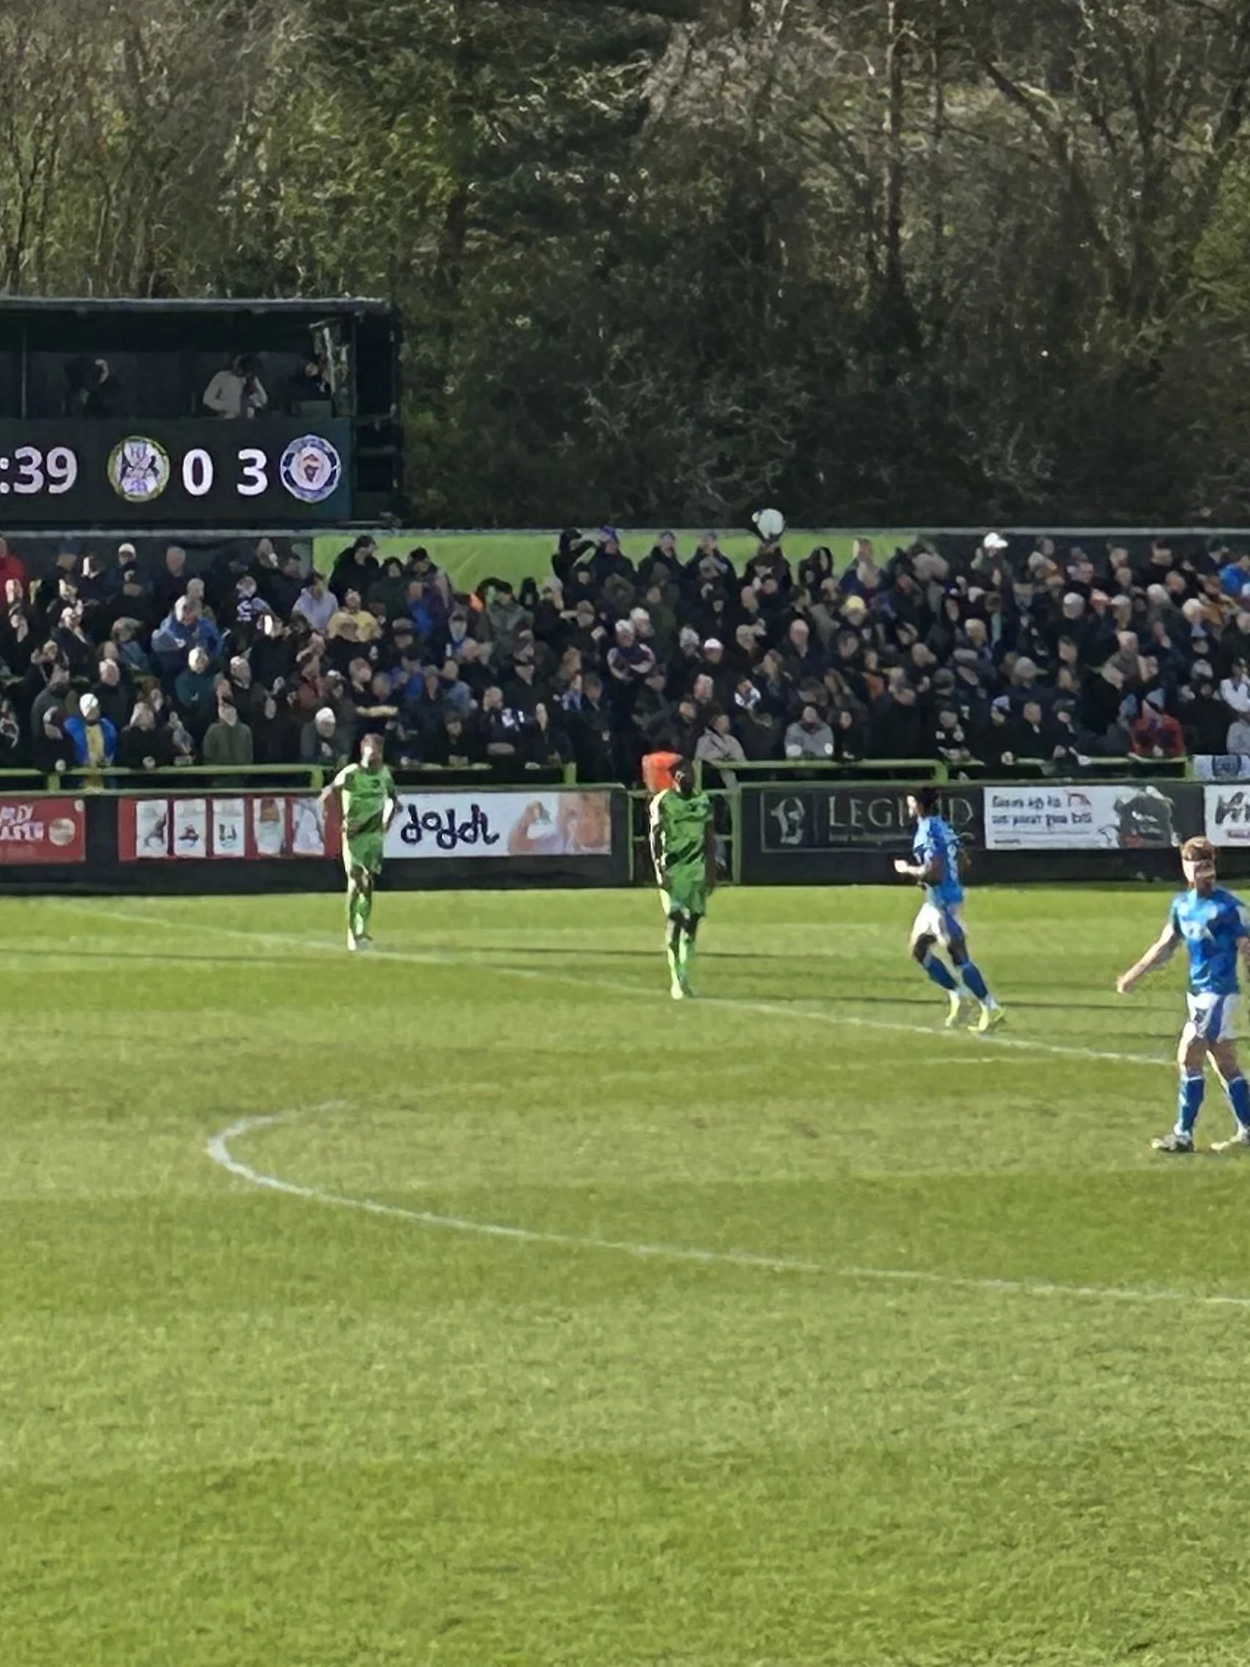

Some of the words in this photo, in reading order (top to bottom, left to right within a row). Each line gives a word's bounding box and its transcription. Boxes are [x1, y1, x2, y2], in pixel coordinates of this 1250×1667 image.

[182, 448, 214, 497] 0
[236, 448, 269, 497] 3
[828, 794, 975, 828] LEGD
